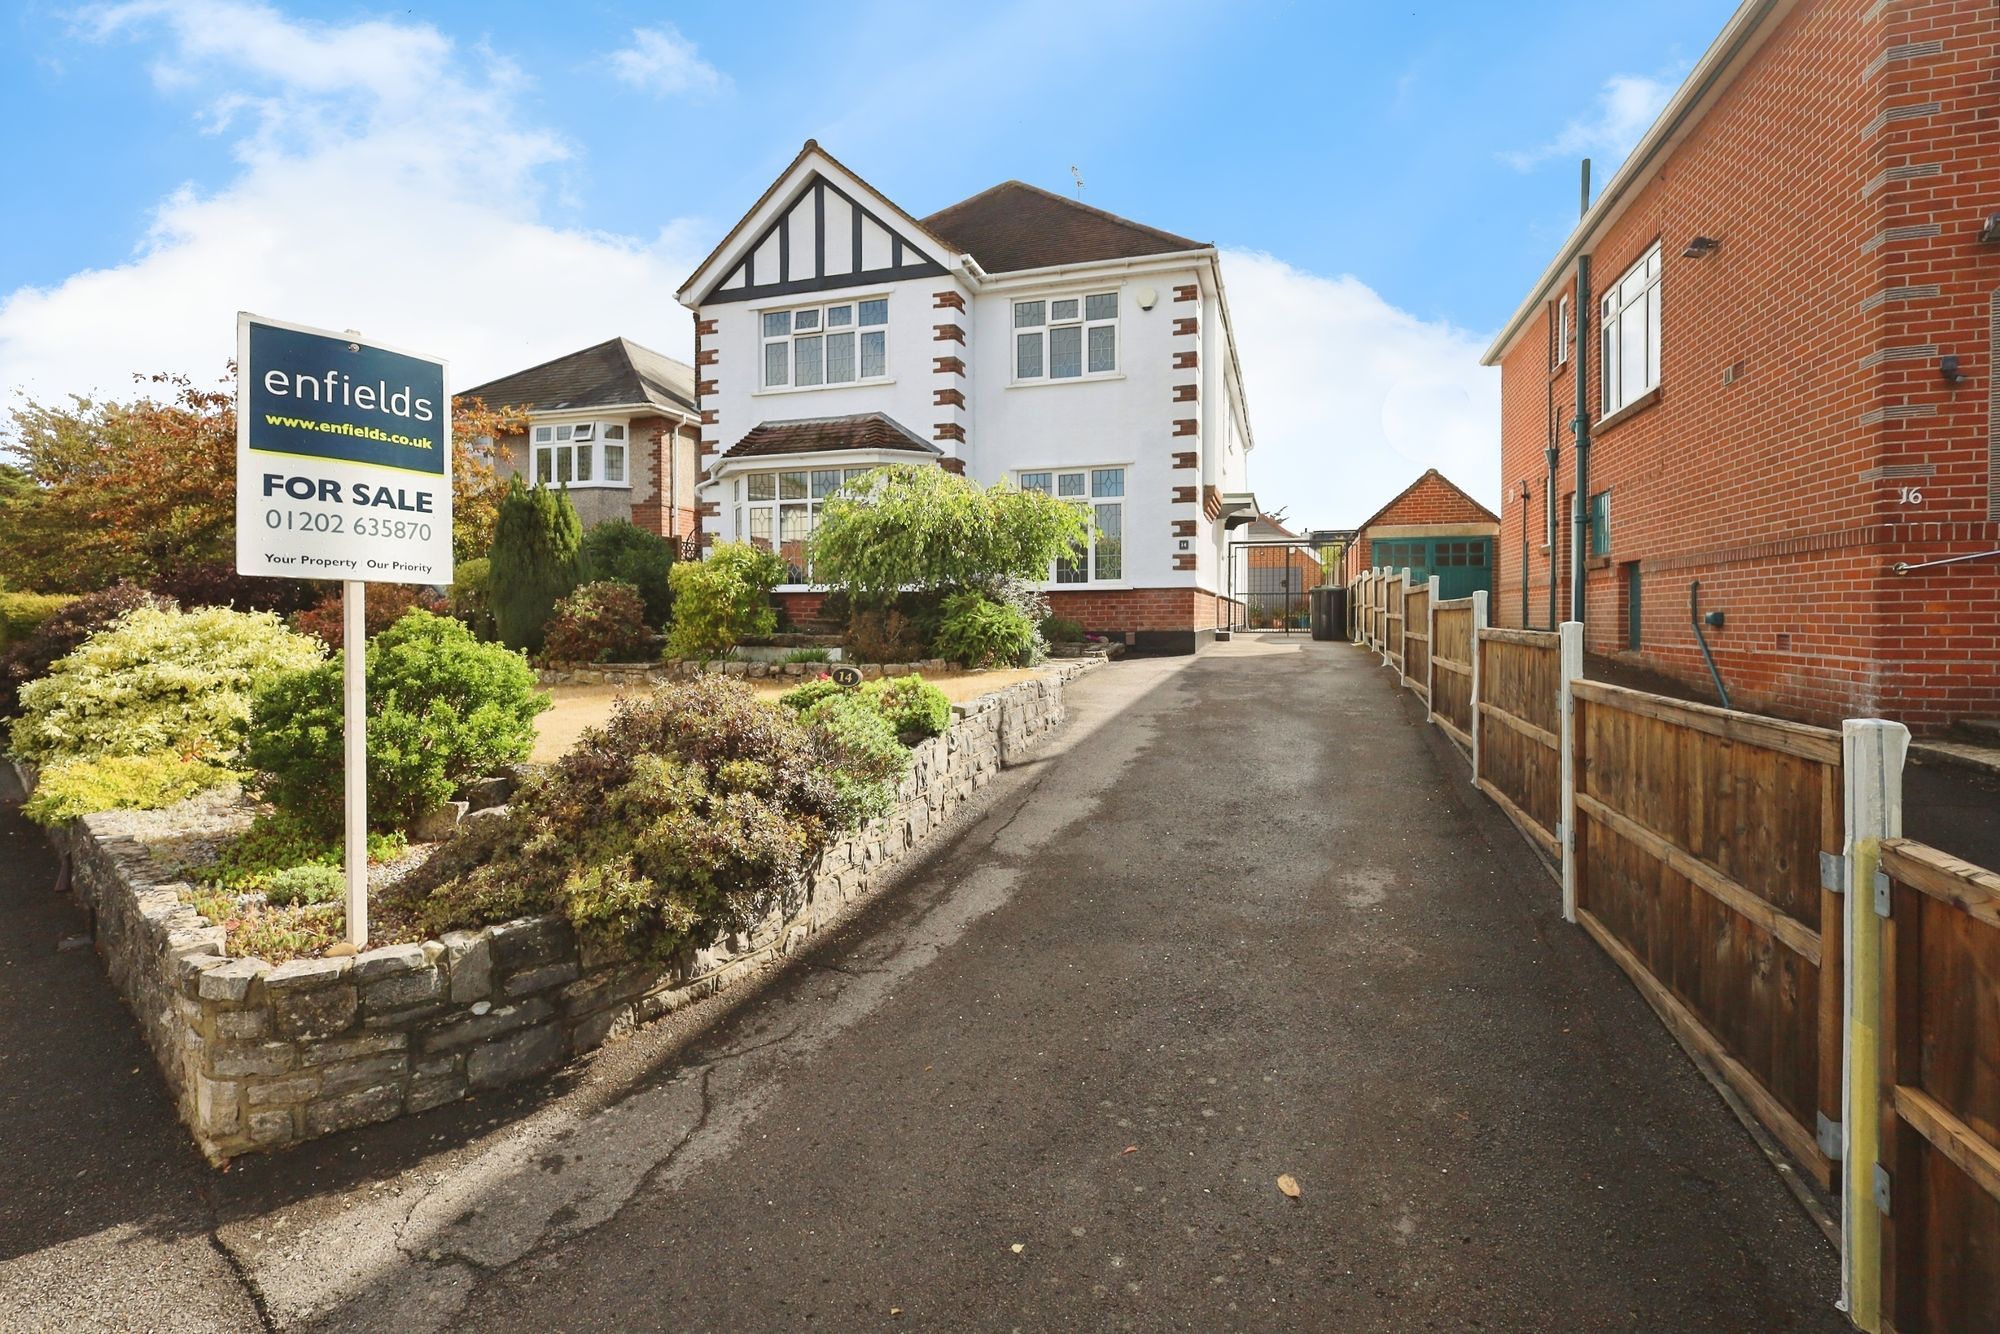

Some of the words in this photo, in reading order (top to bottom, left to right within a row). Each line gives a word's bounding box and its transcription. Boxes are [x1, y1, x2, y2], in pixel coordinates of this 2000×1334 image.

[264, 368, 433, 421] enfields
[265, 413, 433, 450] www.enfields.co.uk
[263, 474, 343, 503] FOR
[352, 483, 433, 513] SALE
[1899, 486, 1922, 504] 16
[265, 509, 345, 533] 01202
[353, 517, 432, 541] 635870
[265, 554, 297, 564] Your
[301, 555, 357, 569] Property
[366, 560, 389, 569] Our
[392, 562, 433, 574] Priority
[839, 671, 853, 683] 14
